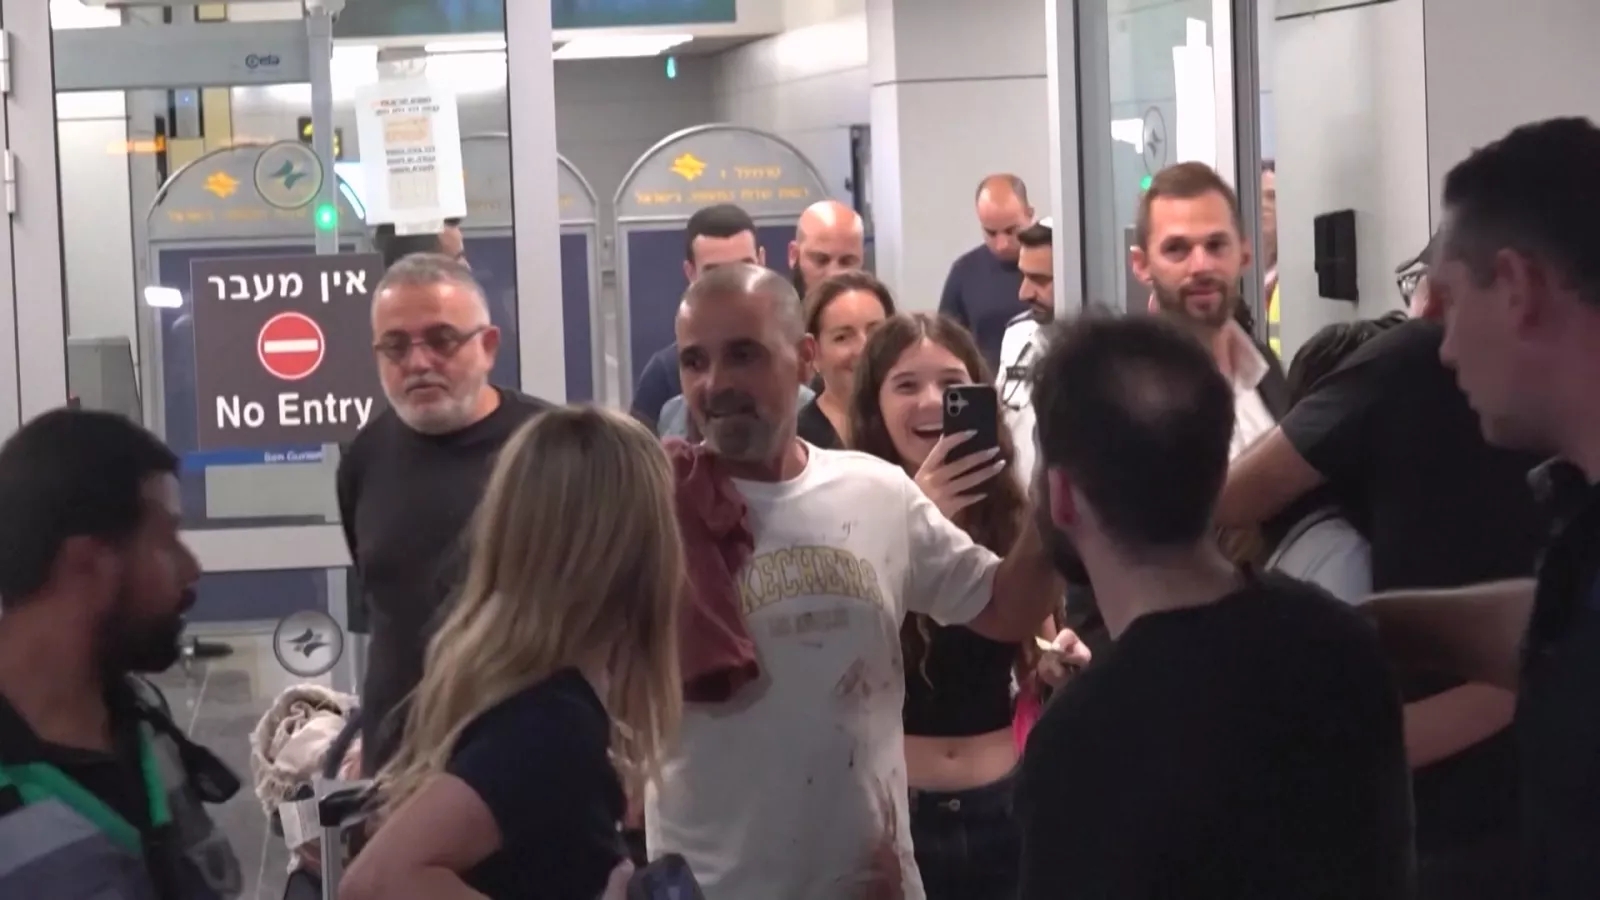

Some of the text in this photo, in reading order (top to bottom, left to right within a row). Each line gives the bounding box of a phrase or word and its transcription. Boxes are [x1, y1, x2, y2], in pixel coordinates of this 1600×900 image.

[208, 269, 367, 303] אין מעבר
[216, 392, 374, 431] No Entry
[738, 545, 884, 615] KECHERS
